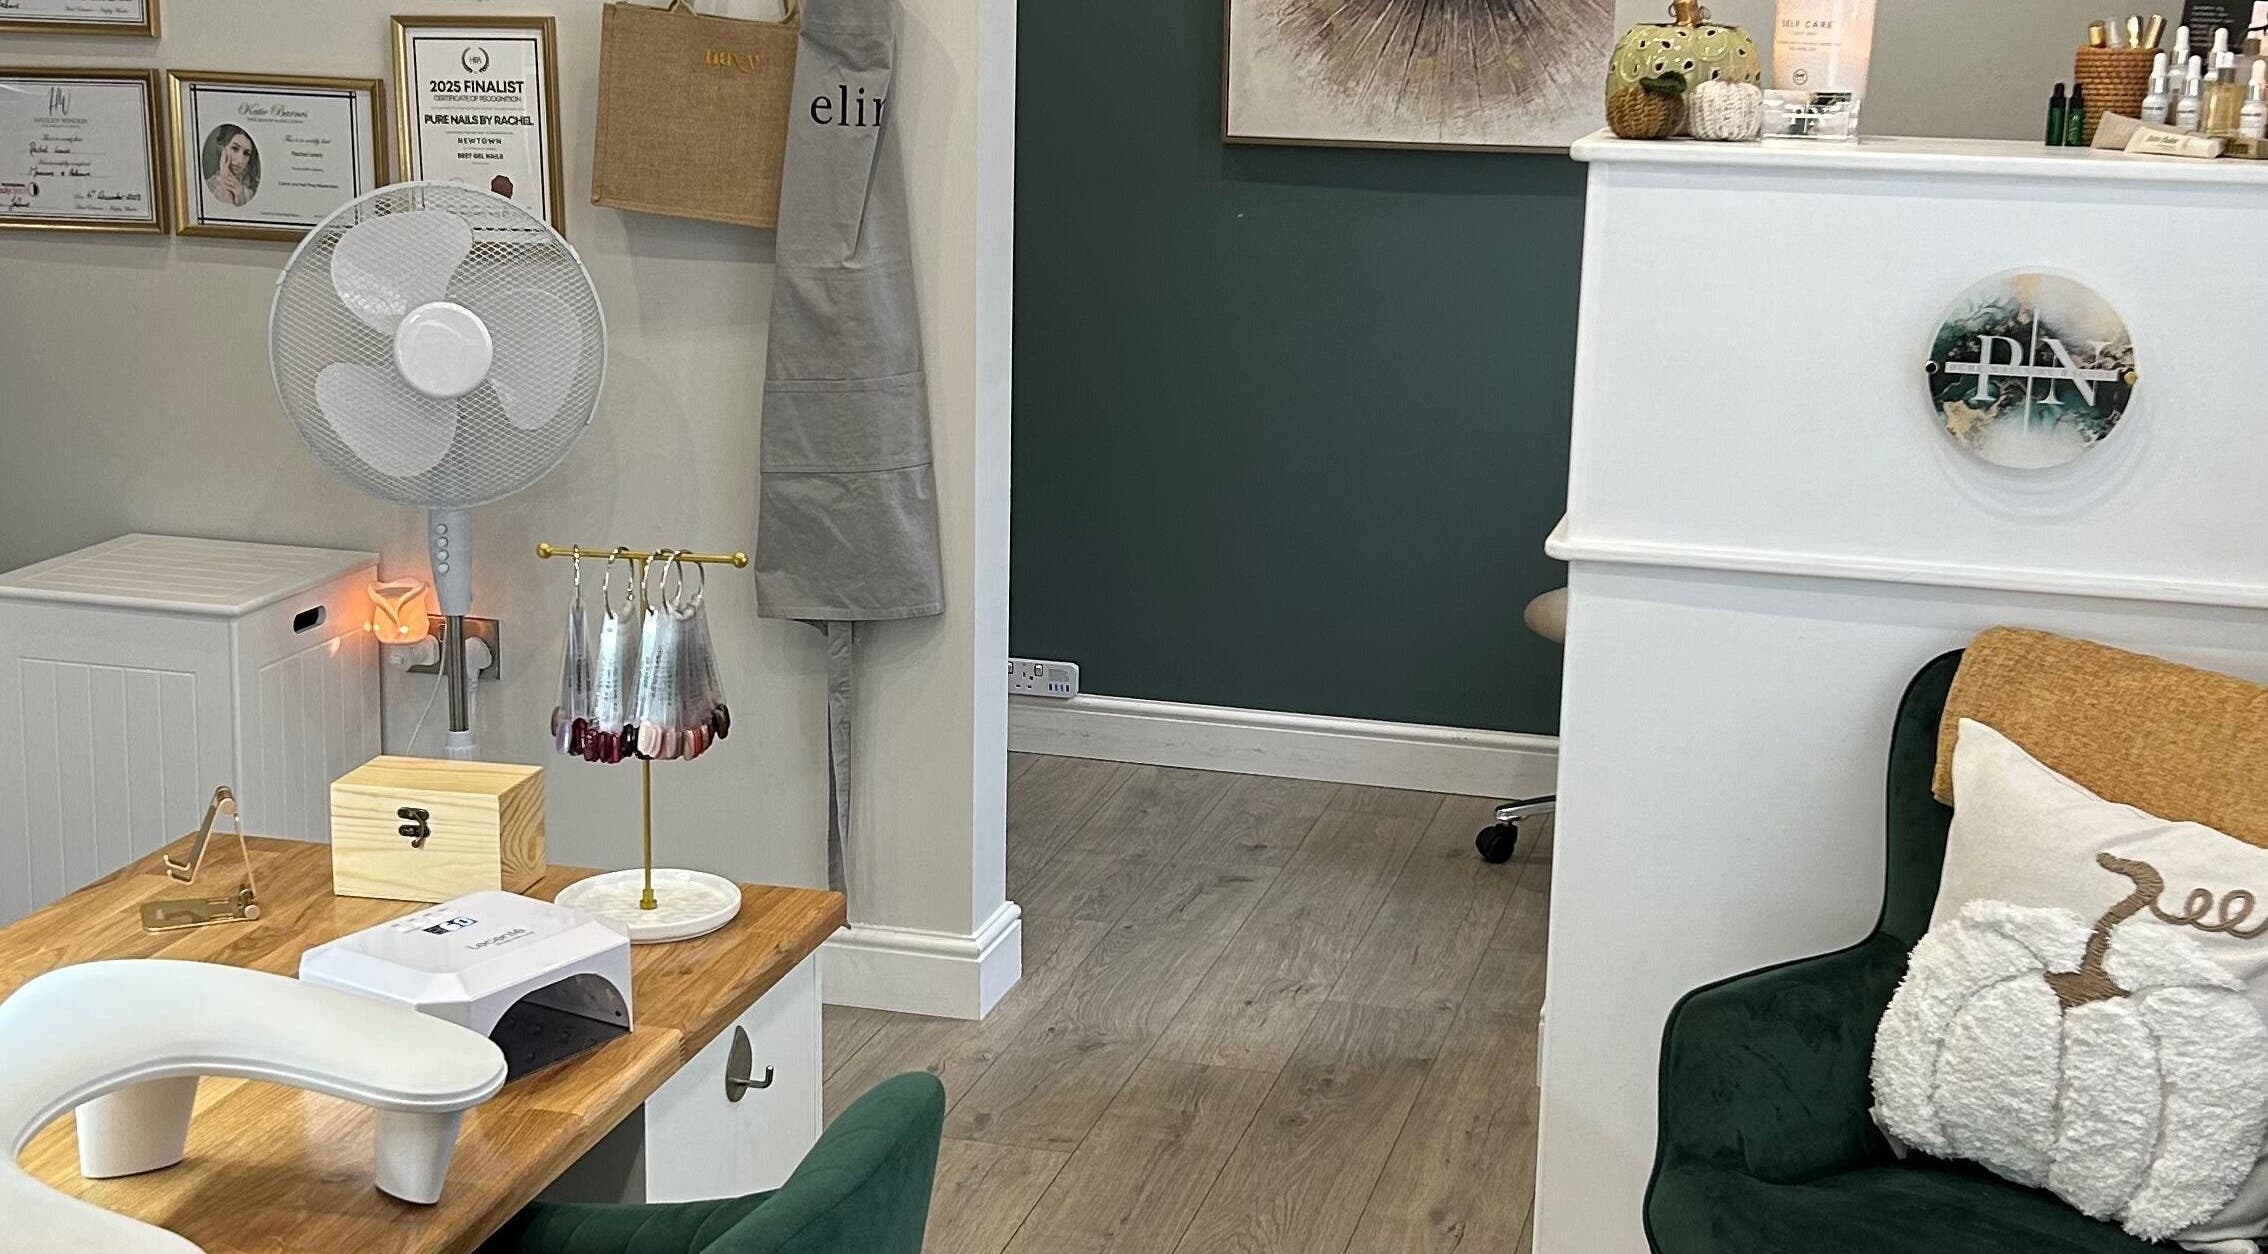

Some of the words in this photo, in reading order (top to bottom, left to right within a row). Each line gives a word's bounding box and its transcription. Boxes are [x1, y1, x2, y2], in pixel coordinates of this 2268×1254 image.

[1805, 20, 1832, 29] CARE
[430, 80, 461, 93] 2025
[464, 80, 524, 93] FINALIST
[424, 114, 449, 124] PURE
[451, 115, 478, 125] NAILS
[480, 115, 492, 125] BY
[494, 116, 534, 126] RACHEL
[457, 137, 502, 145] NEWTOWN
